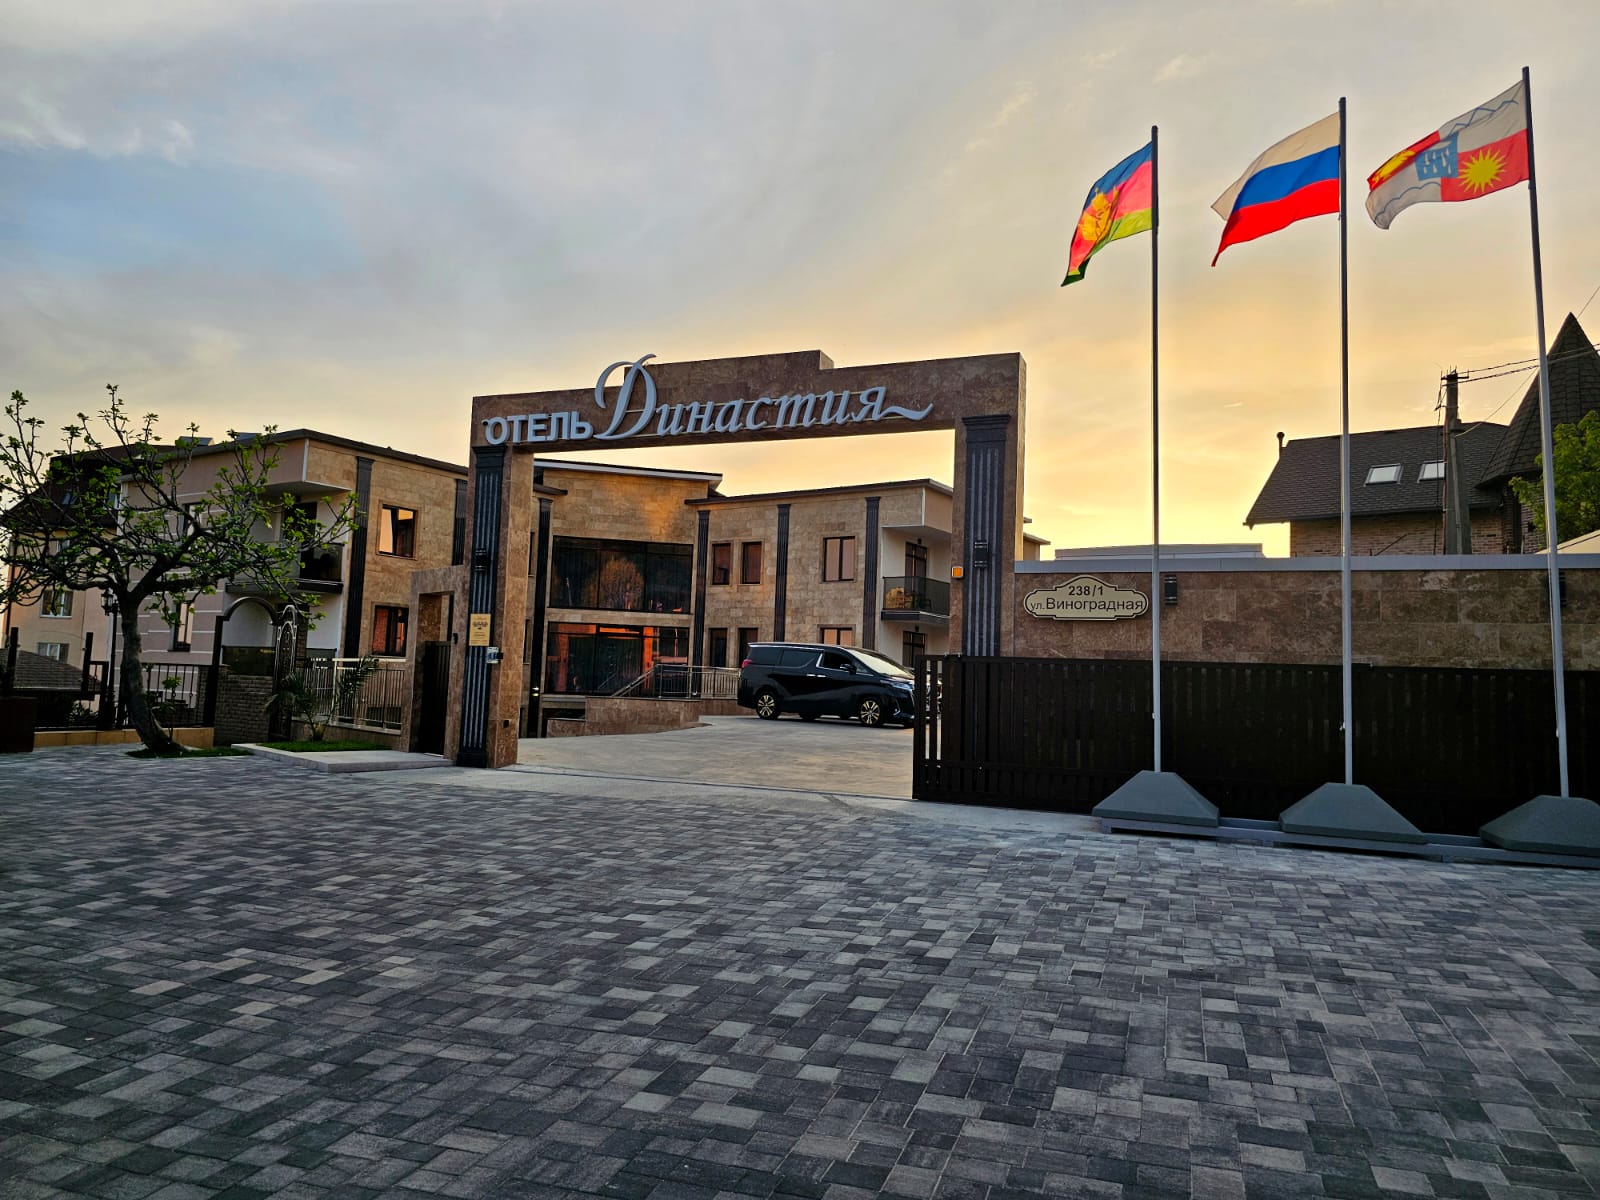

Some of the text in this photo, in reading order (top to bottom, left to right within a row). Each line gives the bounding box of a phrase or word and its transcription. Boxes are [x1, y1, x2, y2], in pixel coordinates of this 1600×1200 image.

[483, 353, 934, 446] ОТЕЛЬ Династия
[1068, 585, 1104, 597] 238/1
[1030, 598, 1144, 612] ул. Виноградная
